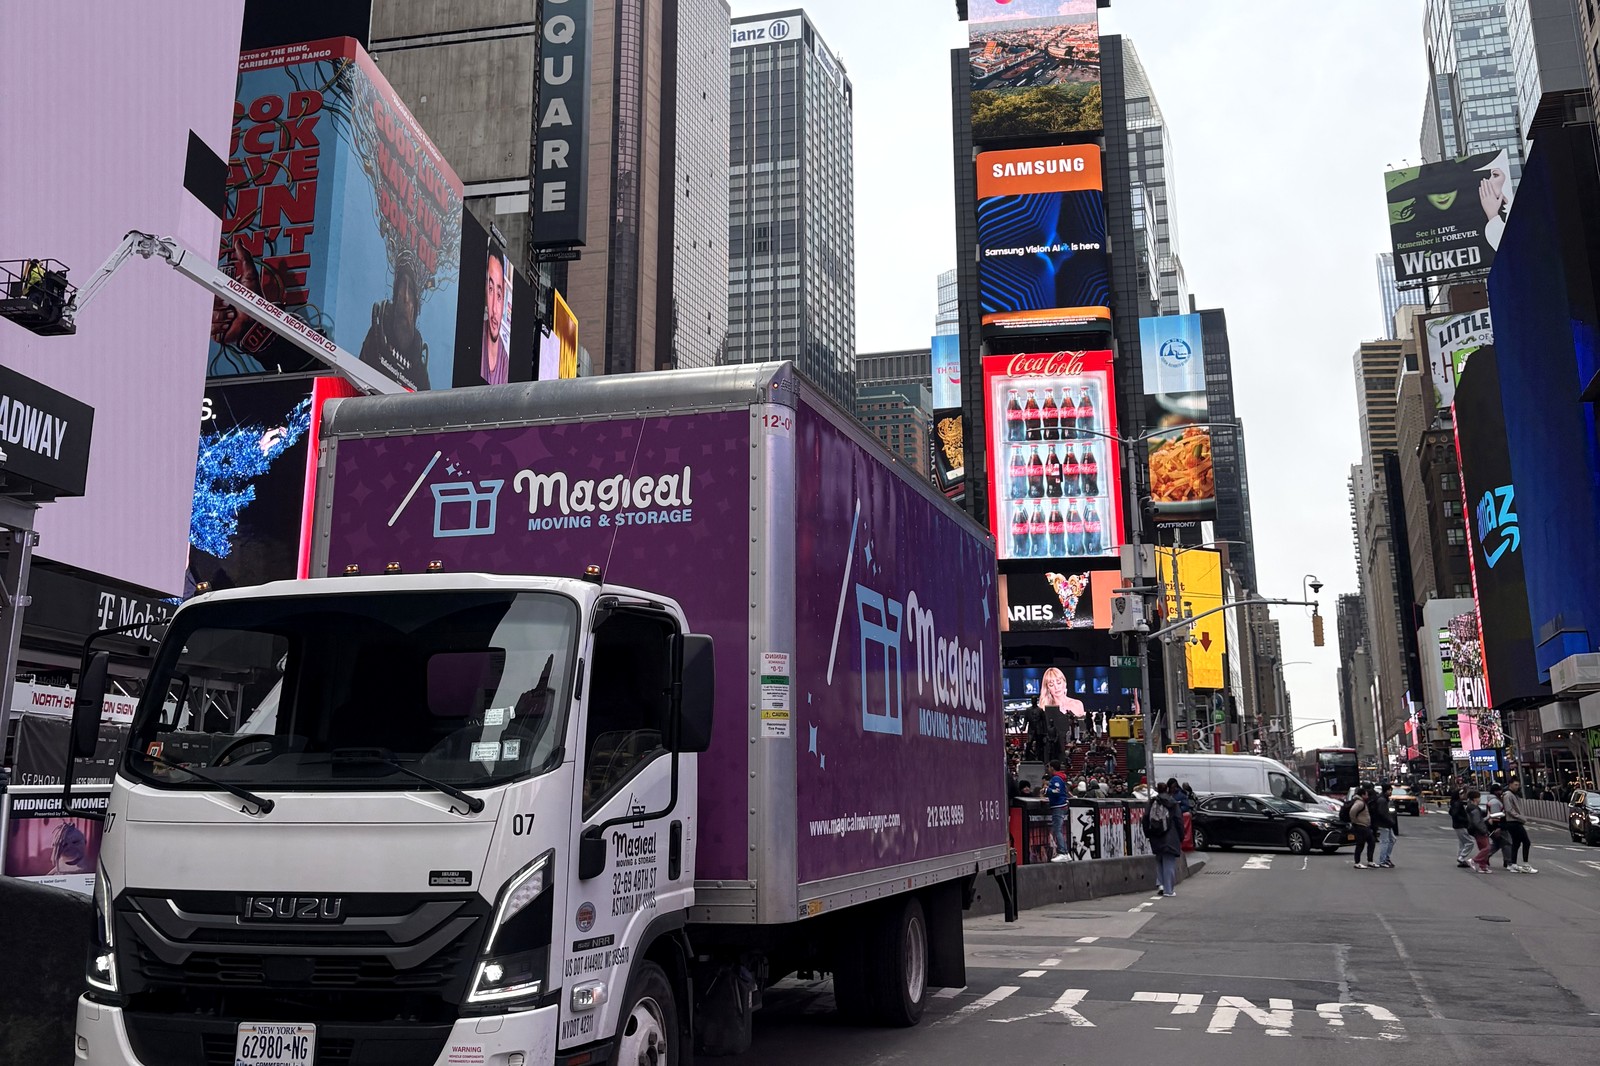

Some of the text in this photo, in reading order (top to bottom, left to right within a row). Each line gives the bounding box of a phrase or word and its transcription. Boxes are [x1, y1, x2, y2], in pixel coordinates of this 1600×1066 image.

[240, 57, 285, 69] CARIBBEAN
[301, 50, 331, 60] RANGO
[271, 48, 286, 56] THE
[287, 44, 310, 53] RING,
[541, 0, 576, 213] QUARE
[373, 99, 449, 214] GOOD LUCK
[992, 157, 1085, 178] SAMSUNG
[378, 141, 441, 248] HAVE FUN
[1396, 239, 1434, 250] Remember
[1415, 230, 1429, 238] See
[985, 242, 1100, 257] Samsung Vision AI is here
[227, 280, 337, 352] NORTH SHORE NEON SIGN CO
[1438, 312, 1491, 349] LITTLE
[1007, 351, 1088, 377] Coca-Cola
[0, 395, 68, 460] ADWAY
[513, 465, 693, 515] Magical
[528, 508, 692, 531] MOVING & STORAGE
[1008, 604, 1053, 620] ARIES
[906, 590, 986, 714] Magical
[32, 692, 62, 708] NORTH
[117, 702, 135, 716] SIGN
[919, 707, 988, 745] MOVING & STORAGE
[14, 798, 64, 811] MIDNIGH
[926, 805, 938, 828] 212
[938, 804, 951, 826] 933
[513, 814, 535, 836] 07
[809, 811, 900, 838] www.magicalmovingnyc.com
[612, 830, 657, 858] Magical
[616, 858, 633, 868] MOVING
[638, 855, 656, 865] STORAGE
[430, 877, 470, 885] DIESEL
[612, 871, 632, 895] 32-69
[649, 867, 657, 888] ST
[244, 897, 342, 919] ISUZU
[611, 894, 634, 917] ASTORIA
[591, 936, 611, 948] NRR
[565, 958, 573, 977] US
[573, 956, 584, 976] DOT
[257, 1026, 296, 1035] NEW YORK
[242, 1035, 309, 1060] 62980 NG
